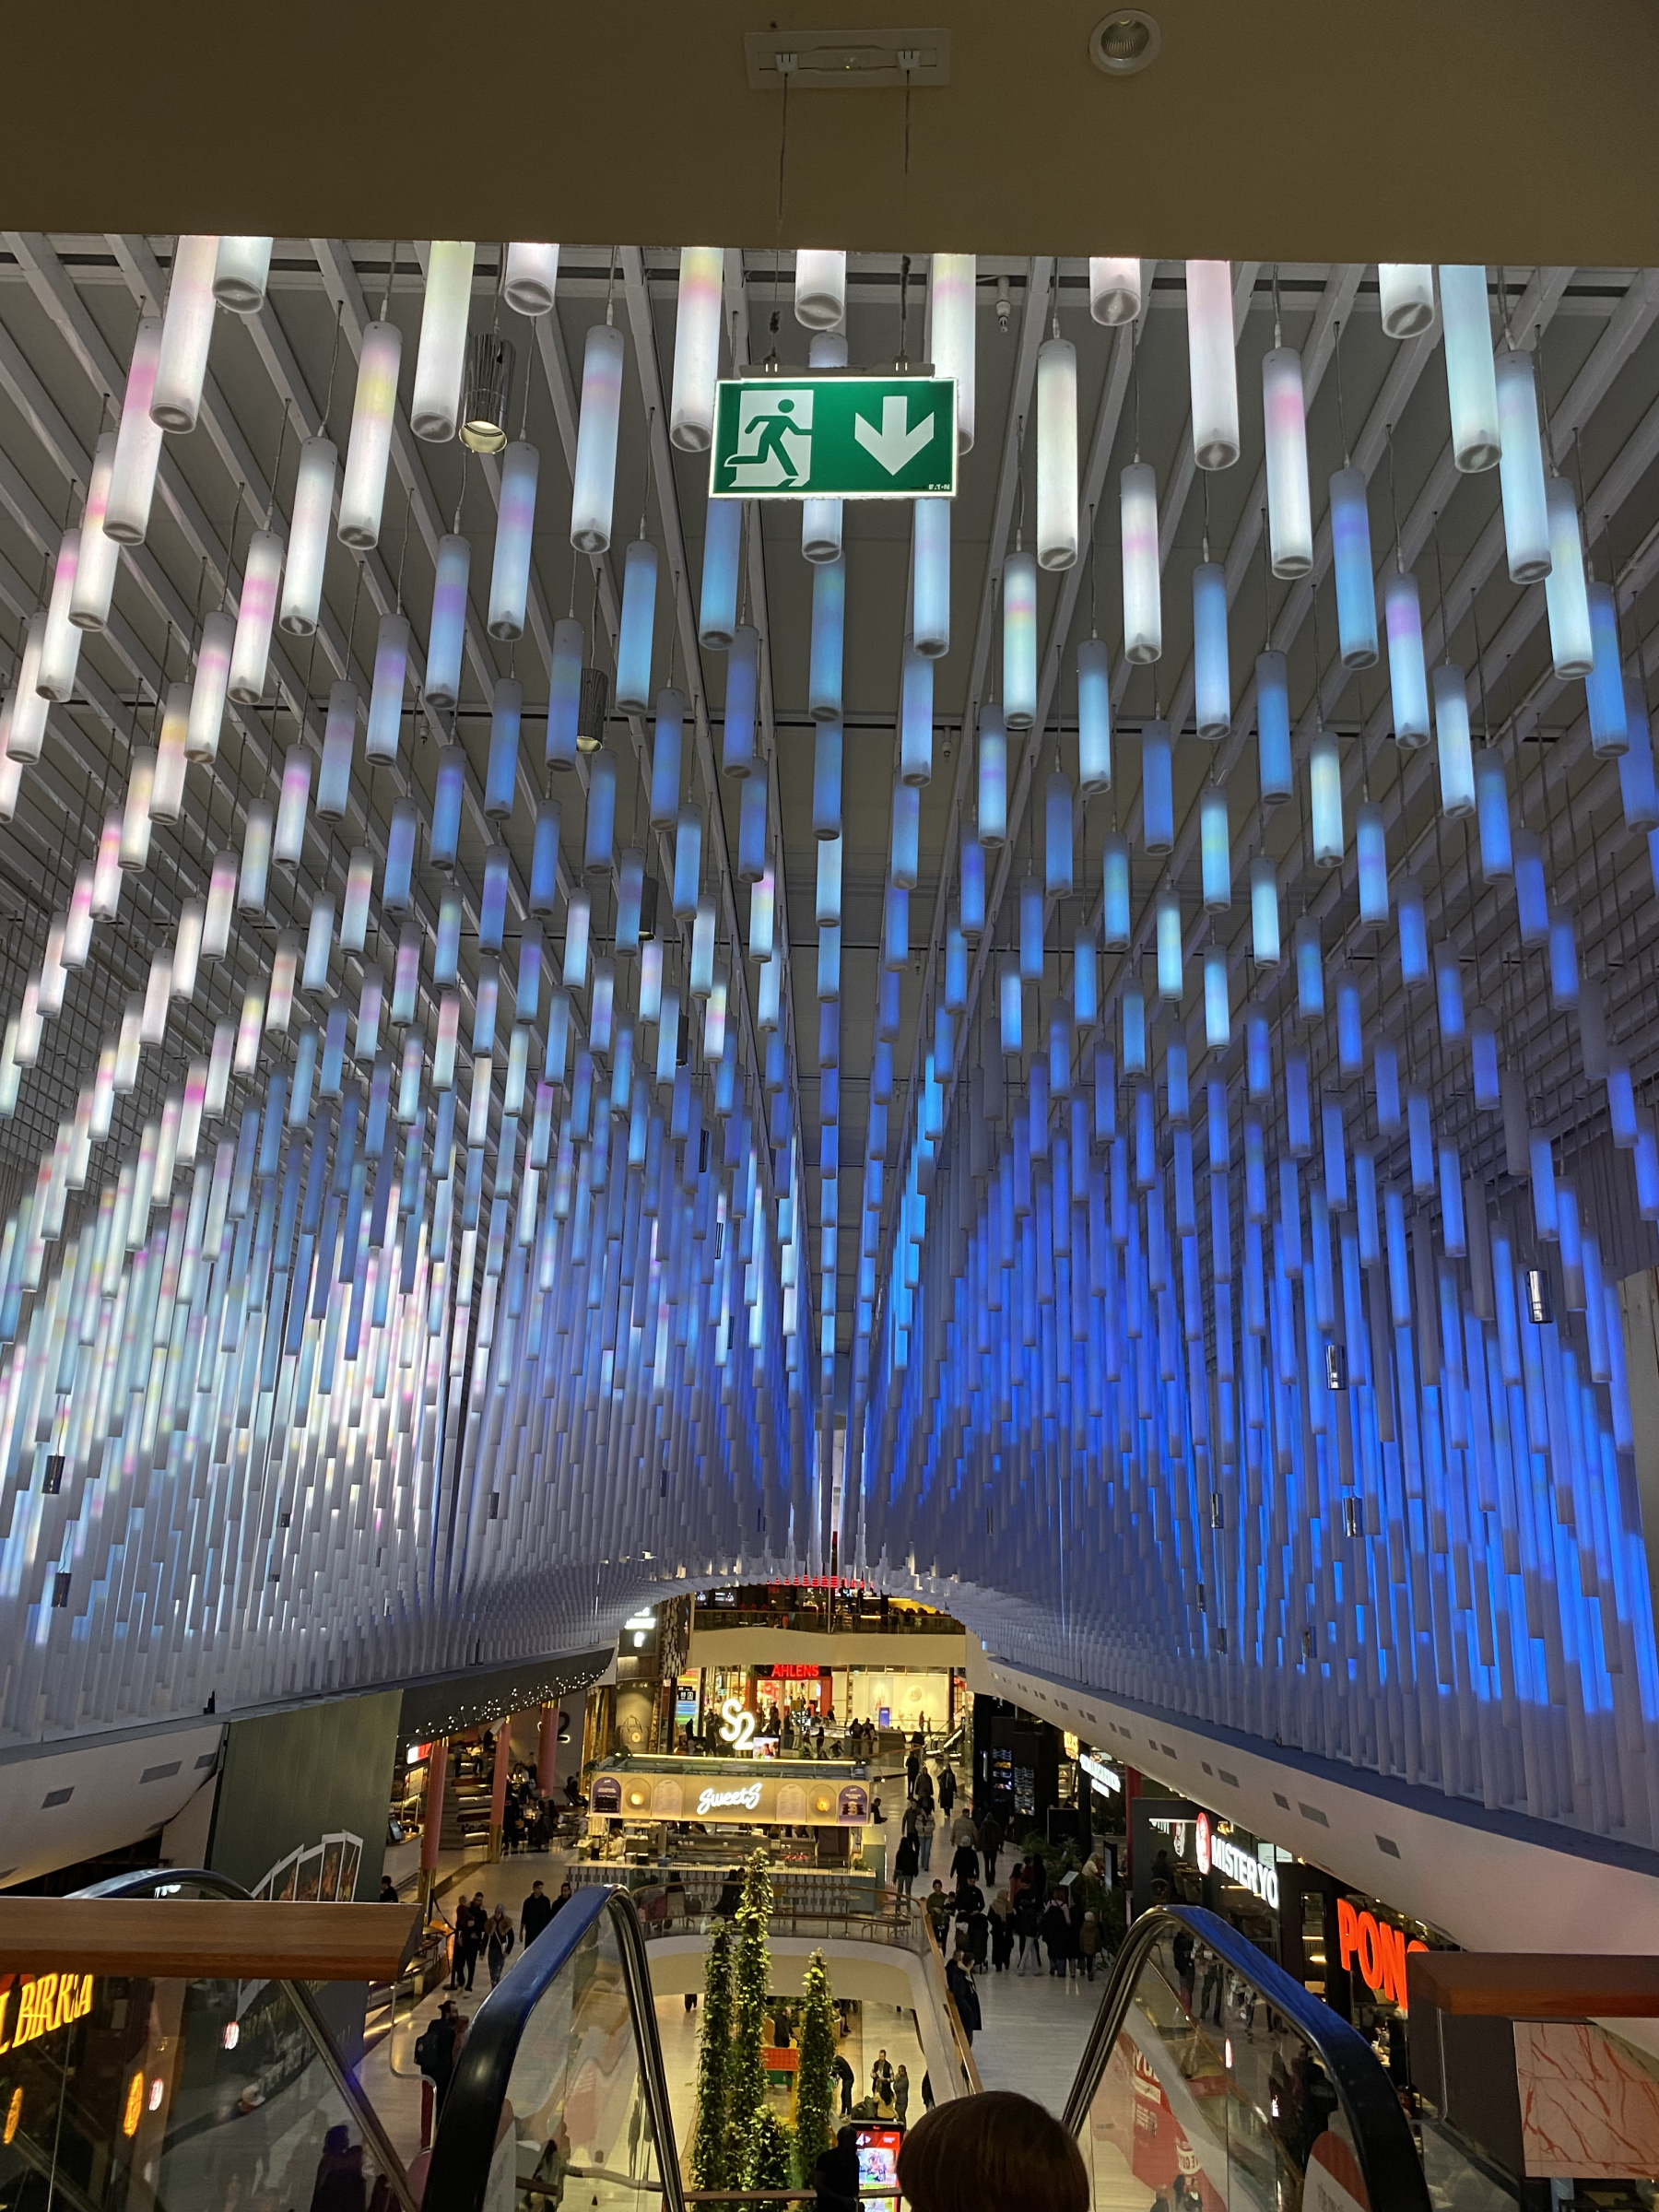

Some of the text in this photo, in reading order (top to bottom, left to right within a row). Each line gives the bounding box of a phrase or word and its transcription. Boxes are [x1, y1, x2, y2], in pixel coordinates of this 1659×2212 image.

[1211, 1834, 1258, 1894] MISTER
[1257, 1863, 1279, 1910] YO
[1337, 1899, 1430, 2017] PON
